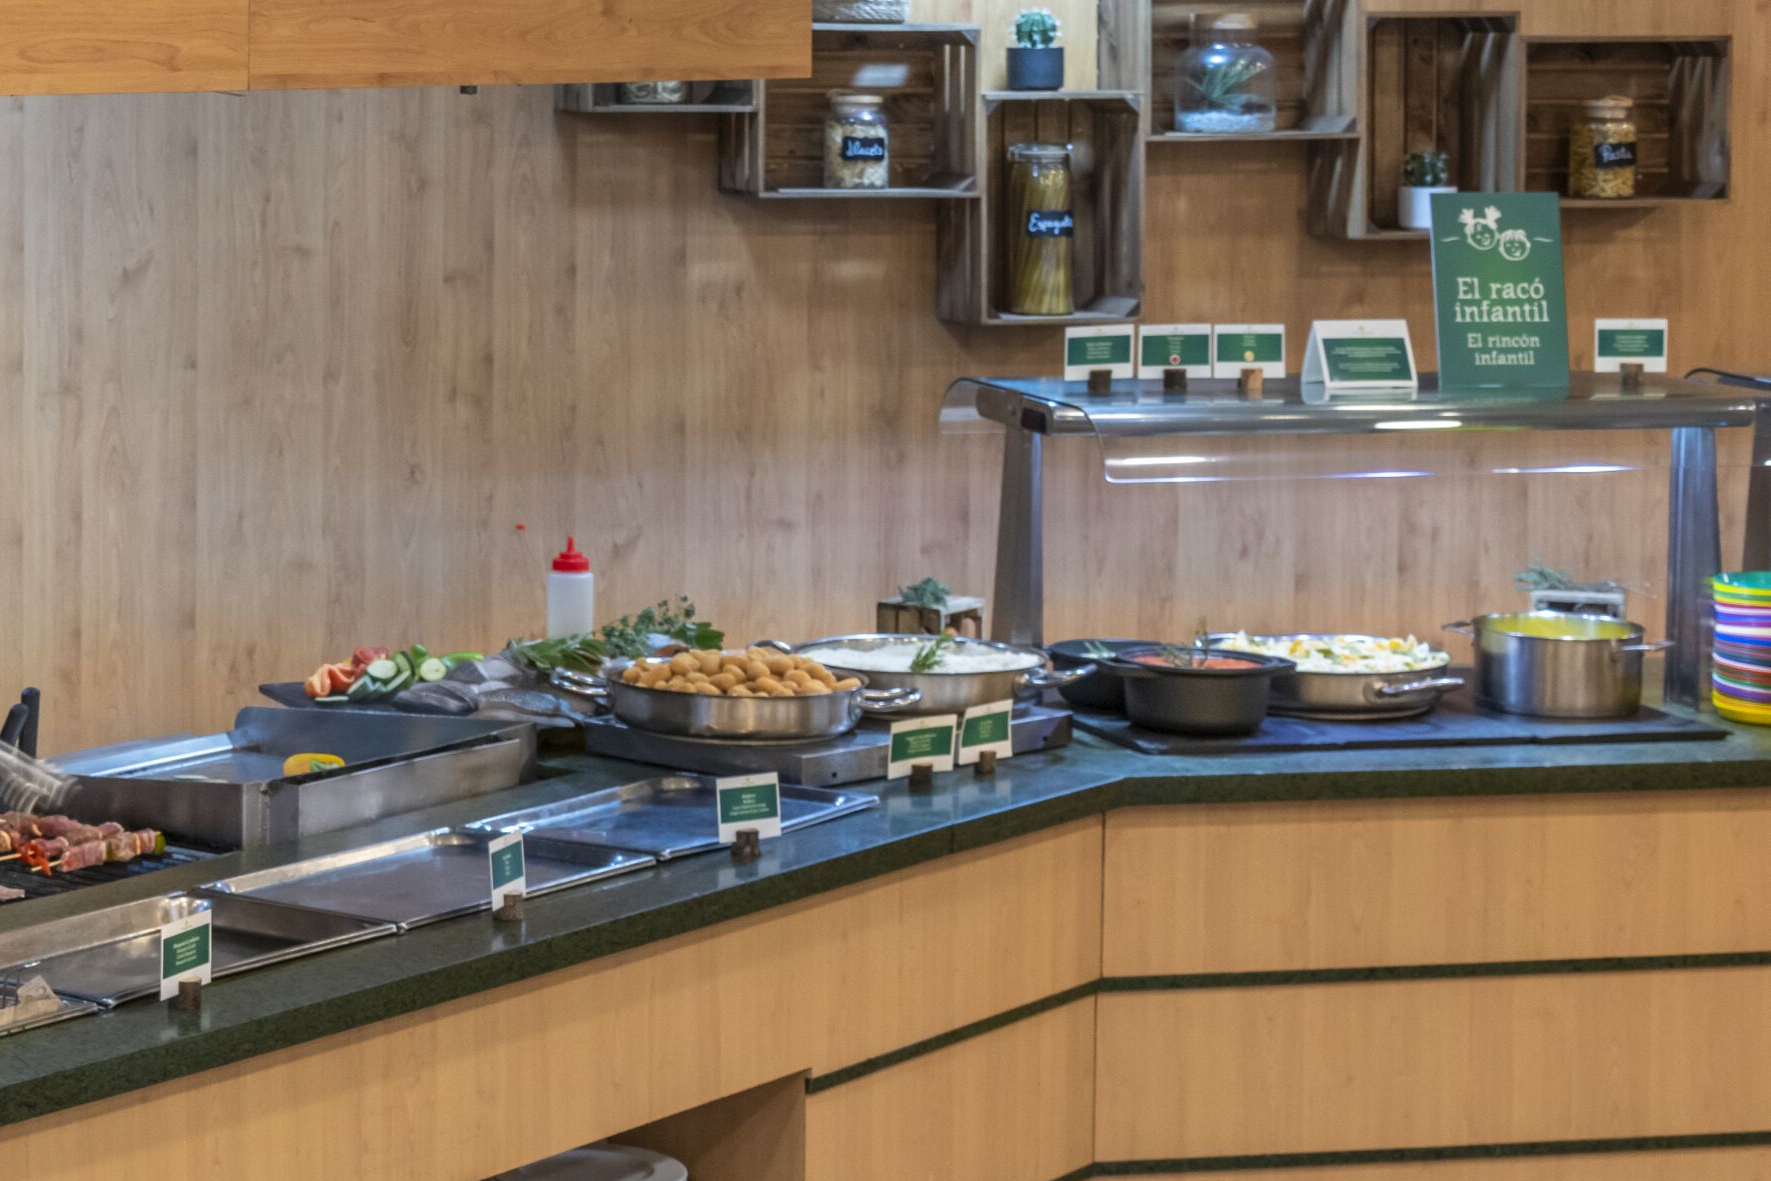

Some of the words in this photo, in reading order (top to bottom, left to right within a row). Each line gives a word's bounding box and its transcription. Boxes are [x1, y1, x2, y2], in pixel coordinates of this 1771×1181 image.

[1456, 277, 1481, 299] El
[1489, 277, 1545, 299] racó
[1454, 300, 1550, 322] infantil
[1467, 333, 1482, 348] El
[1488, 333, 1540, 348] rincón
[1475, 351, 1535, 365] infantil
